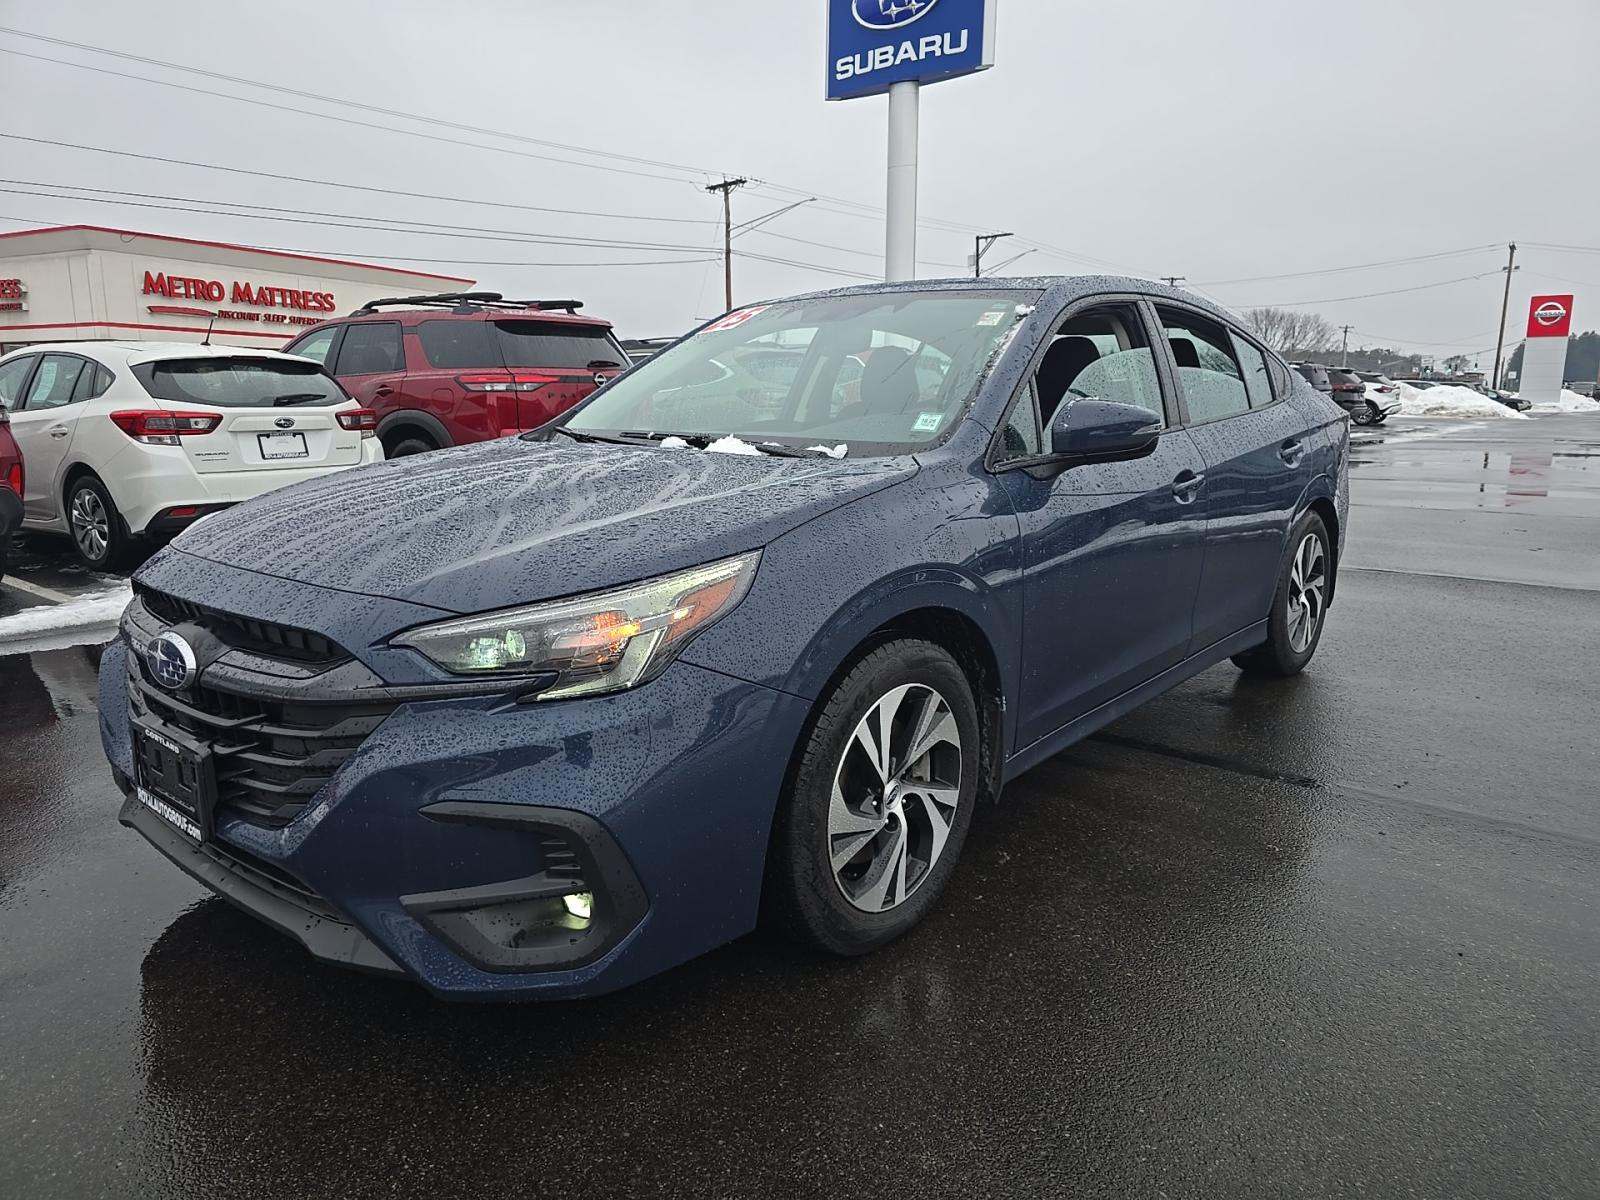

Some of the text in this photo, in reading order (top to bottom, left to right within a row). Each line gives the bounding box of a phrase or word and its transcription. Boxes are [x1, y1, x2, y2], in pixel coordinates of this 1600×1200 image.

[835, 29, 968, 81] SUBARU
[143, 271, 336, 312] METRO MATTRESS
[218, 310, 261, 322] DISCOUNT
[263, 313, 286, 323] SLEEP
[145, 729, 180, 754] CORTLAND
